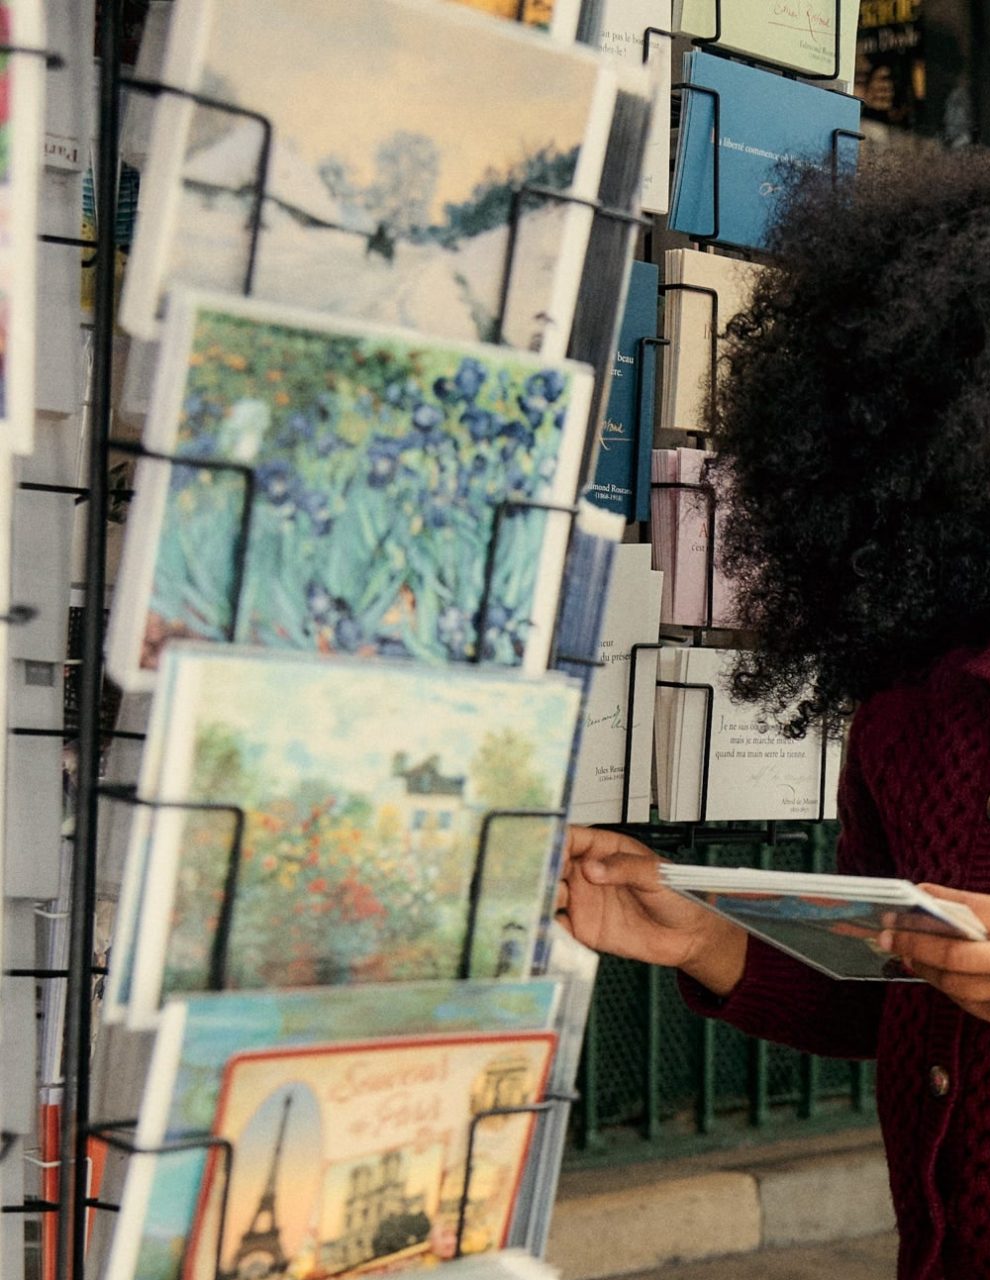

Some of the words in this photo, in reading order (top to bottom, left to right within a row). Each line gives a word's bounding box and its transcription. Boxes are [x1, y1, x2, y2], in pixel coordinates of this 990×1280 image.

[723, 136, 745, 152] liberté
[745, 145, 779, 162] commence
[617, 351, 634, 365] beau
[587, 482, 610, 492] dmond
[611, 651, 635, 665] prése
[718, 714, 728, 734] Je
[729, 723, 737, 731] ne
[730, 734, 745, 744] mais
[746, 735, 752, 745] je
[752, 735, 776, 744] marche
[715, 748, 735, 760] quand
[747, 750, 763, 758] main
[780, 748, 785, 758] la
